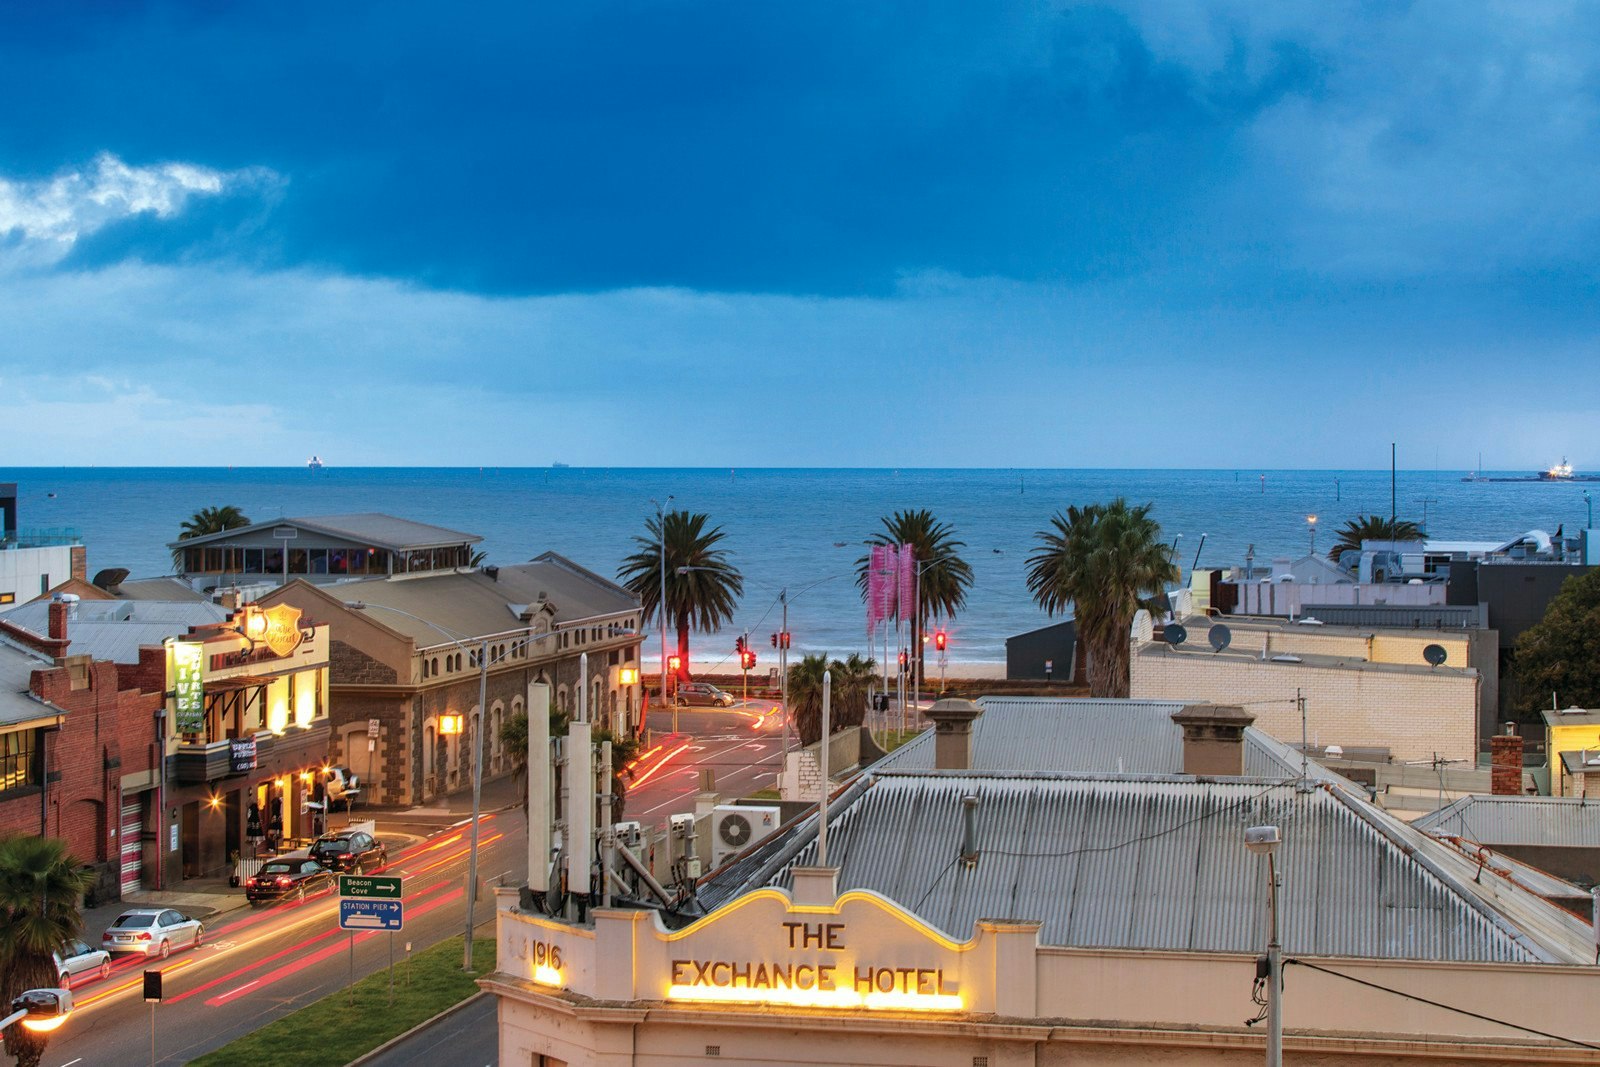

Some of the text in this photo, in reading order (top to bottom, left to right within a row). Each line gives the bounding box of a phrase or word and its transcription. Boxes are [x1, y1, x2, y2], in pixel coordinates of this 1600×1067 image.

[343, 902, 388, 911] STATION PIER
[783, 922, 845, 950] THE
[533, 939, 562, 970] 1916
[672, 959, 961, 996] EXCHANGE HOTEL
